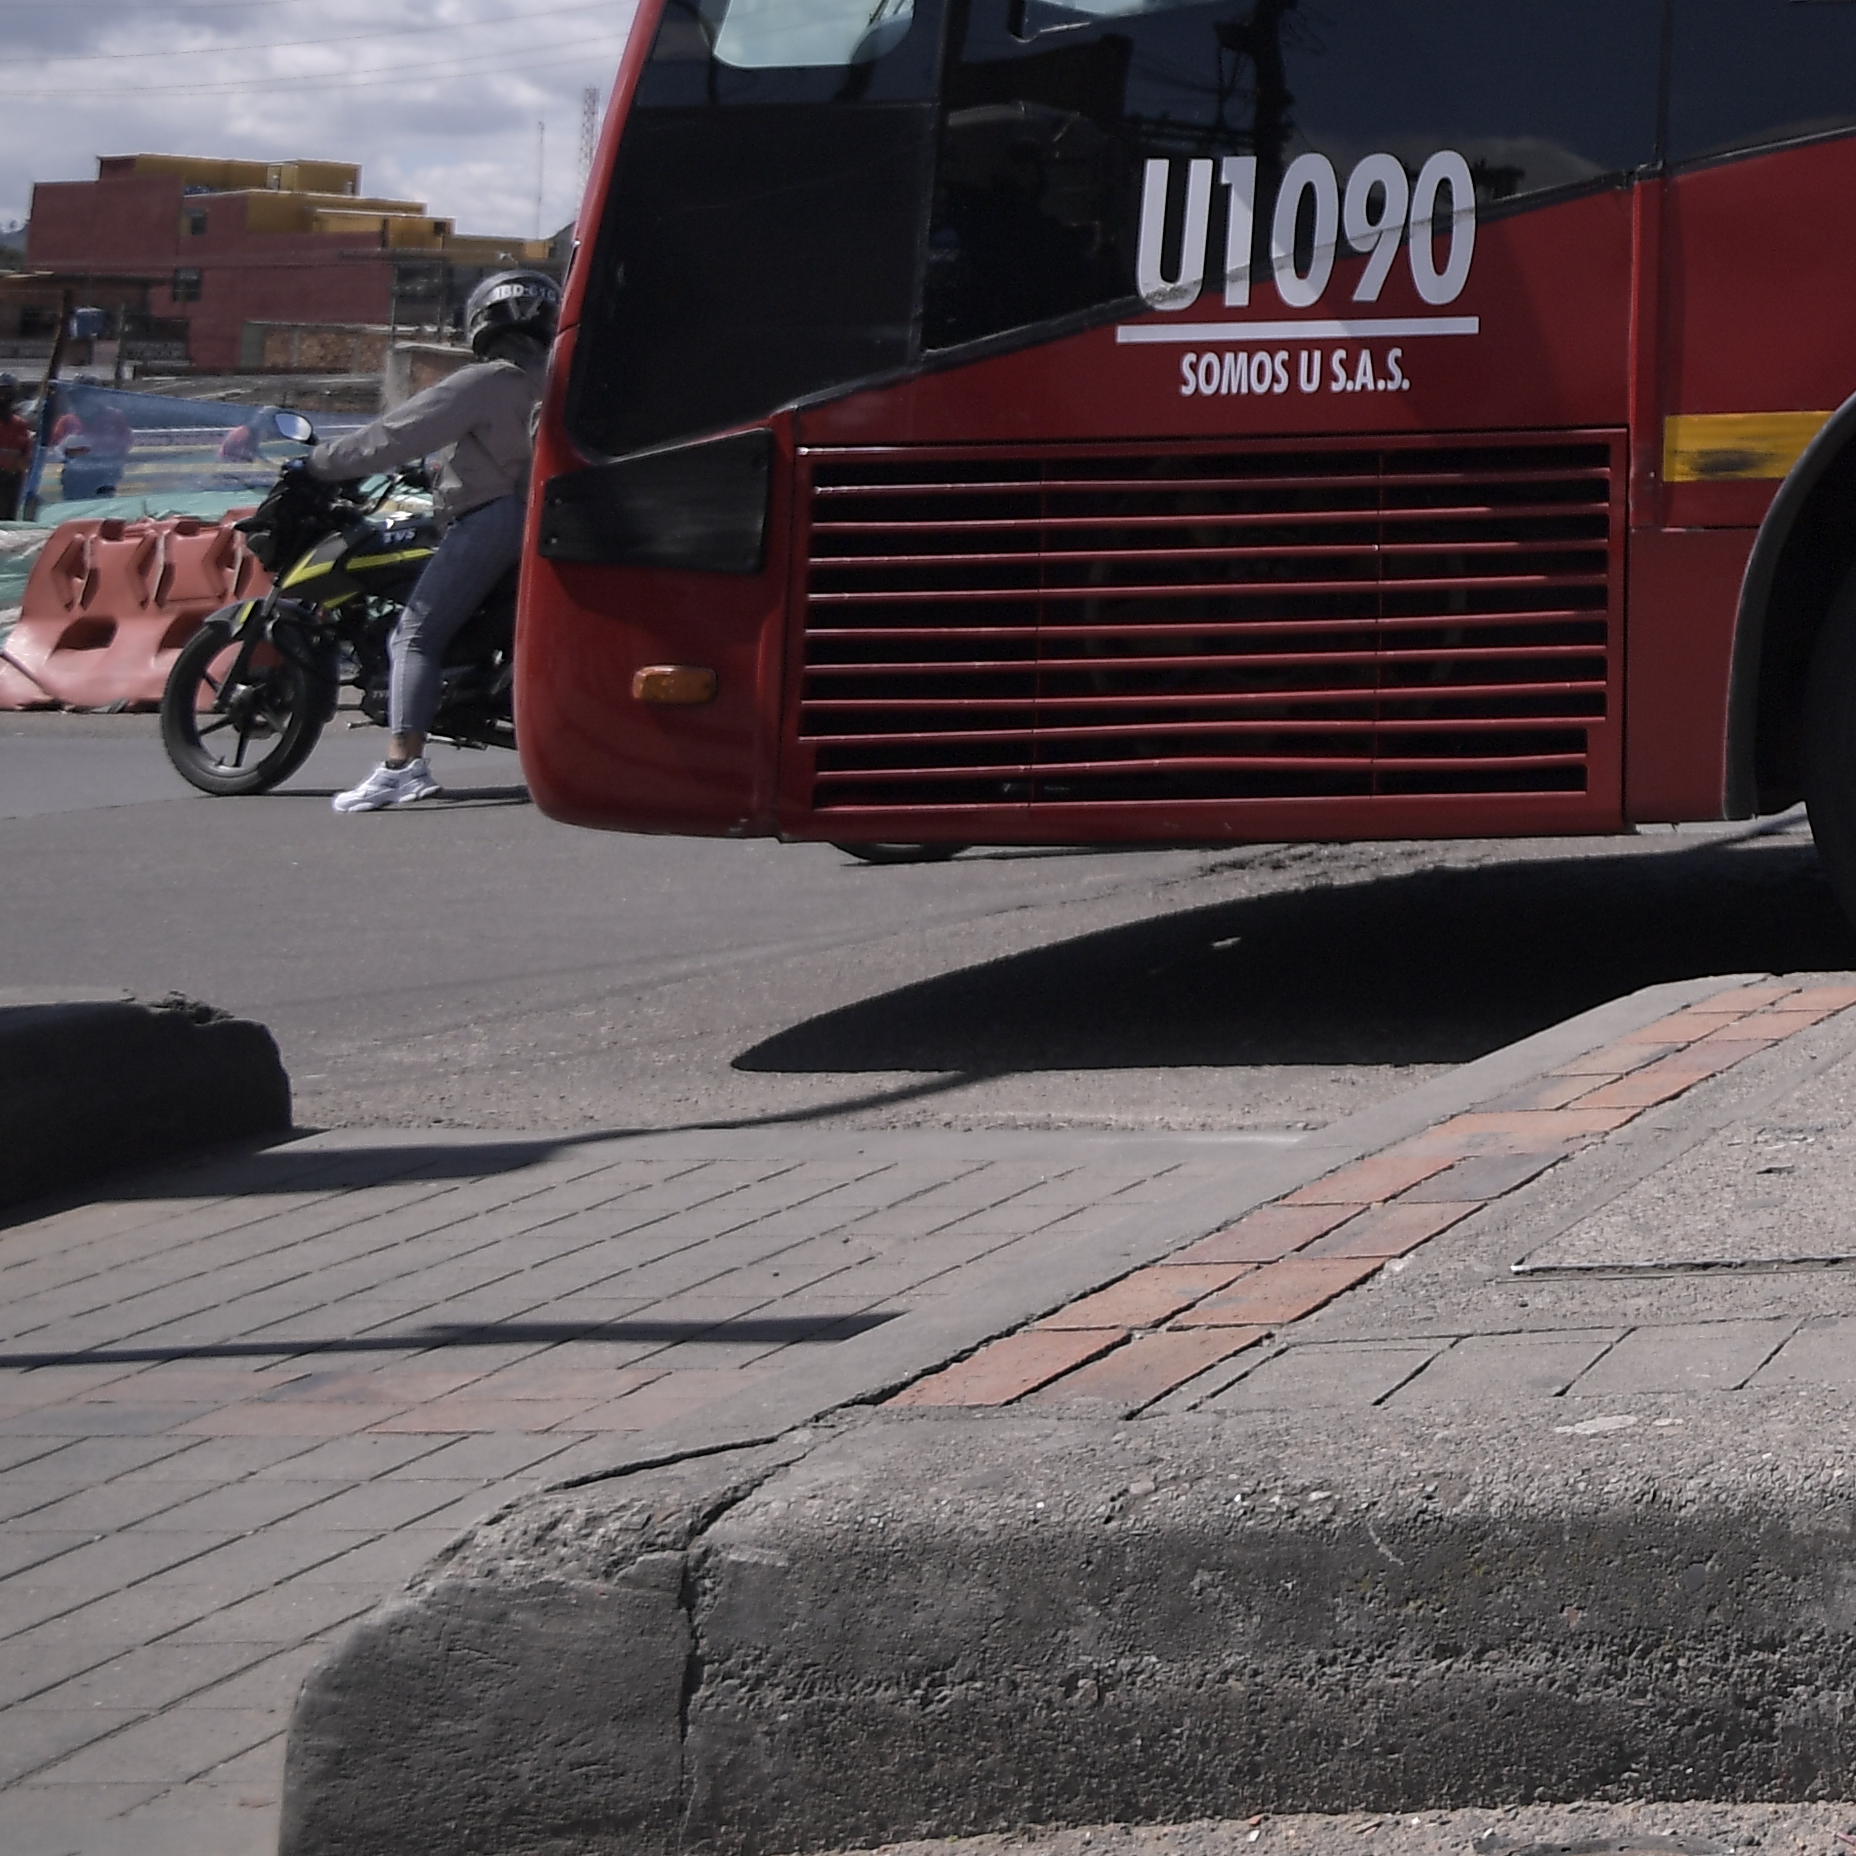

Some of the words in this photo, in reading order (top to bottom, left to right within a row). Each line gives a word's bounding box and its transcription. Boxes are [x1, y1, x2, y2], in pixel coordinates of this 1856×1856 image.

[1136, 149, 1477, 311] U1090
[1180, 350, 1290, 397] SOMOS
[1299, 349, 1322, 393] U
[1330, 347, 1411, 393] S.A.S.
